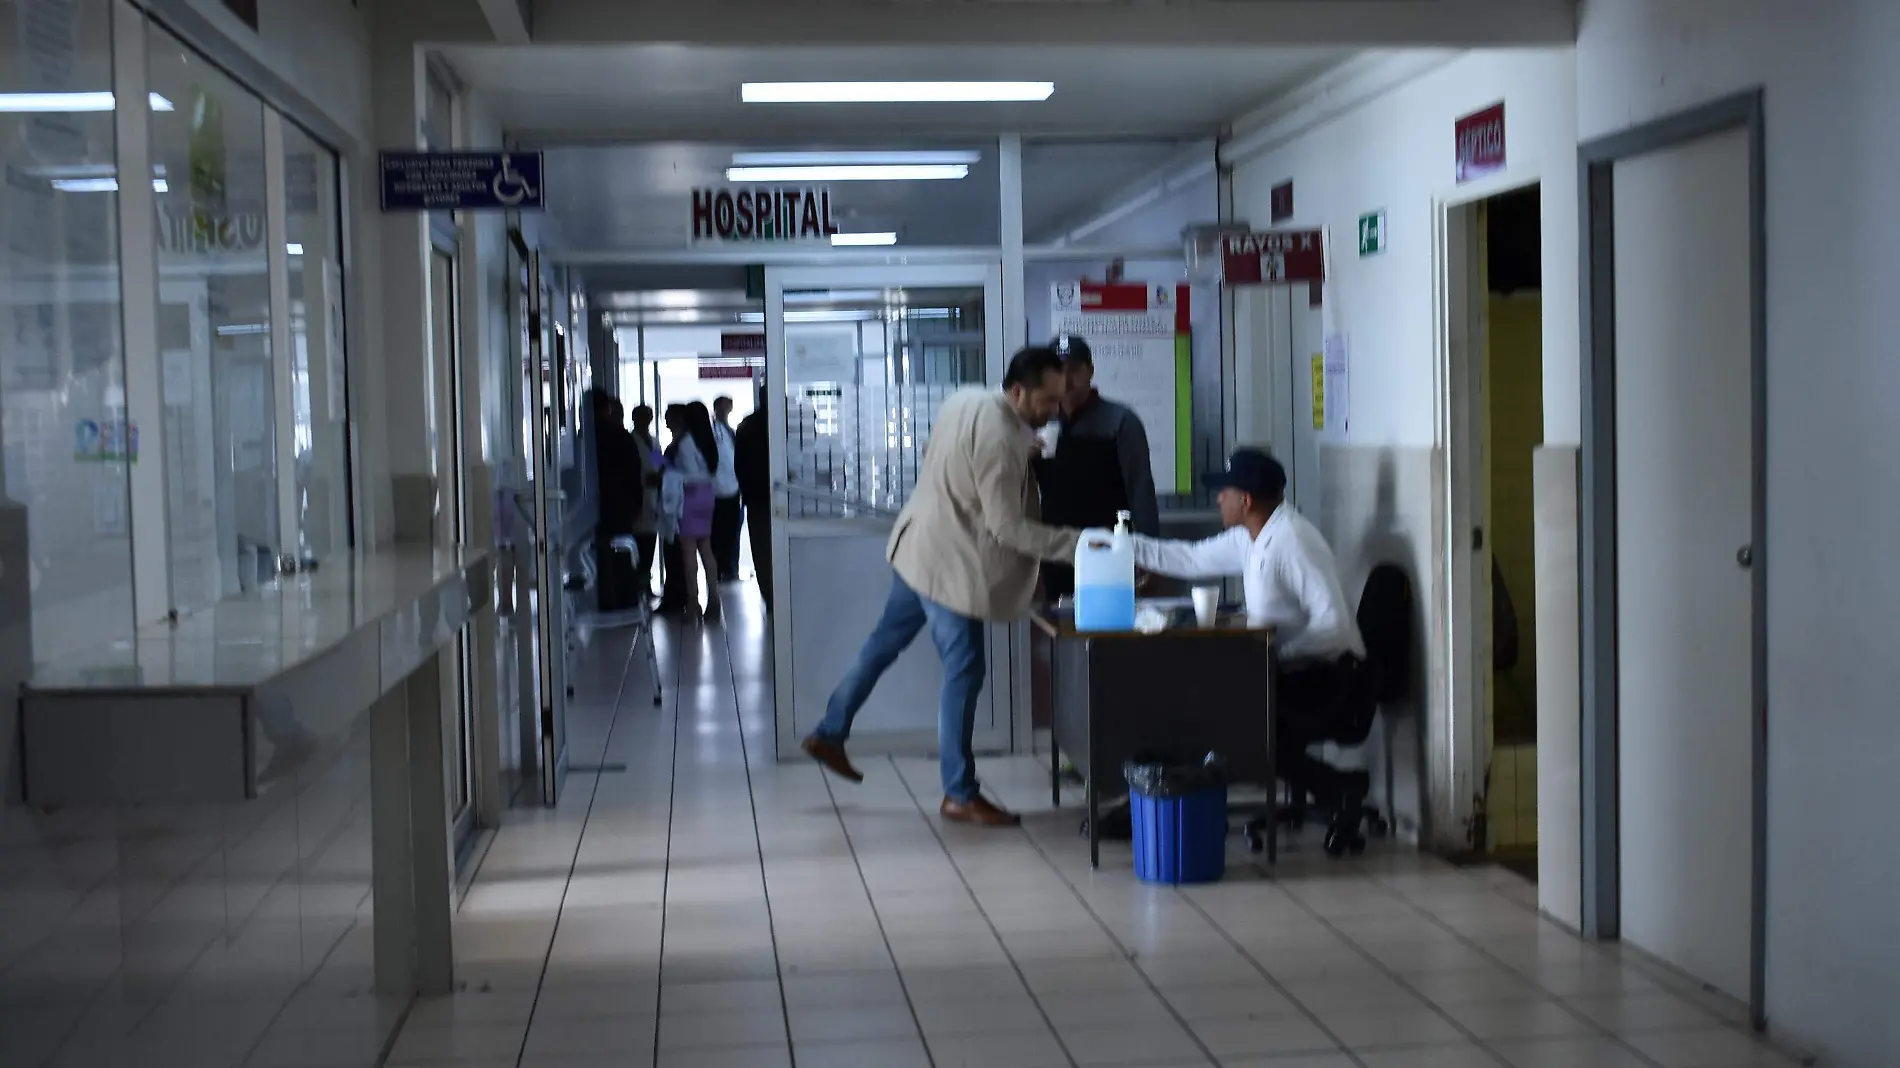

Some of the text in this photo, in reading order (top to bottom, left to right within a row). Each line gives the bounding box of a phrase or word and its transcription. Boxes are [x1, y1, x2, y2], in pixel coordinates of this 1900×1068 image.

[692, 190, 839, 237] HOSPITAL
[1229, 231, 1312, 255] RAYOS X
